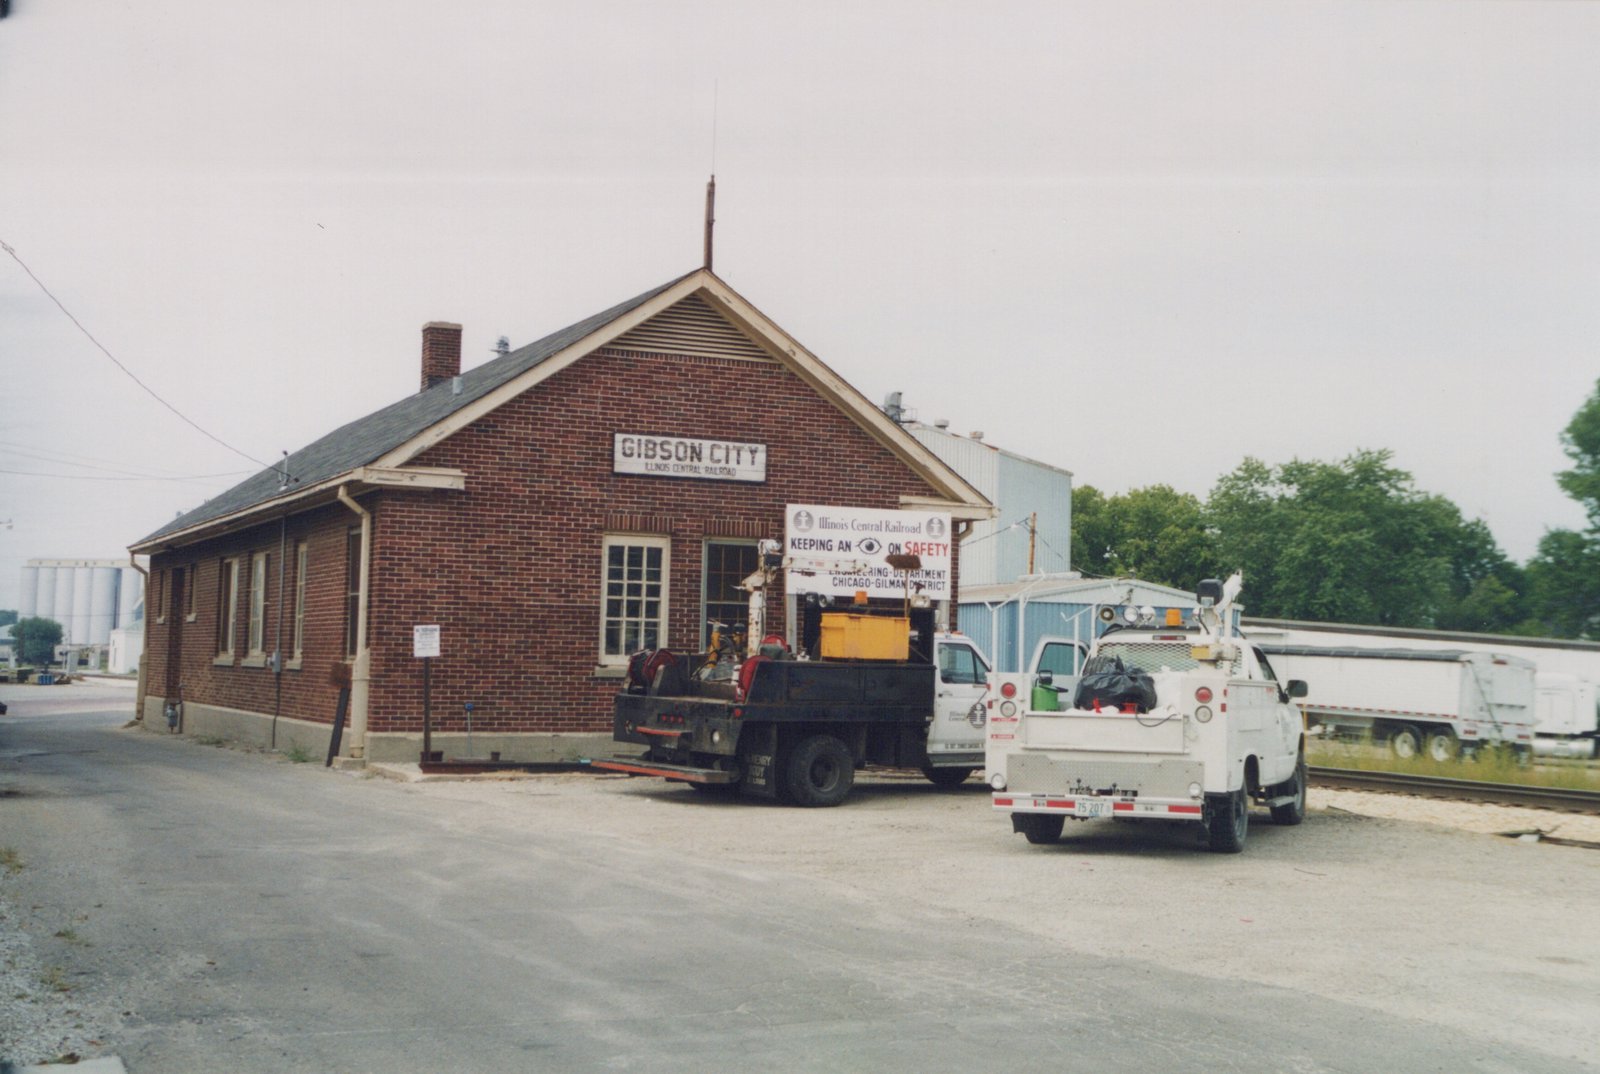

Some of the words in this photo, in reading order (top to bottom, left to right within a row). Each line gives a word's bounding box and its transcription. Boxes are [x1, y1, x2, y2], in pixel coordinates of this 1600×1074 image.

[621, 437, 703, 463] GIBSON
[709, 443, 759, 466] CITY
[645, 462, 670, 472] ILLINOIS
[672, 464, 702, 474] CENTRAL
[705, 466, 736, 477] RAILROAD
[818, 516, 849, 530] Illinois
[851, 518, 883, 533] Central
[884, 521, 922, 534] Railroad
[790, 537, 833, 551] KEEPING
[838, 540, 852, 552] AN
[888, 543, 901, 556] ON
[904, 541, 949, 556] SAFETY
[909, 579, 946, 591] DTRICT
